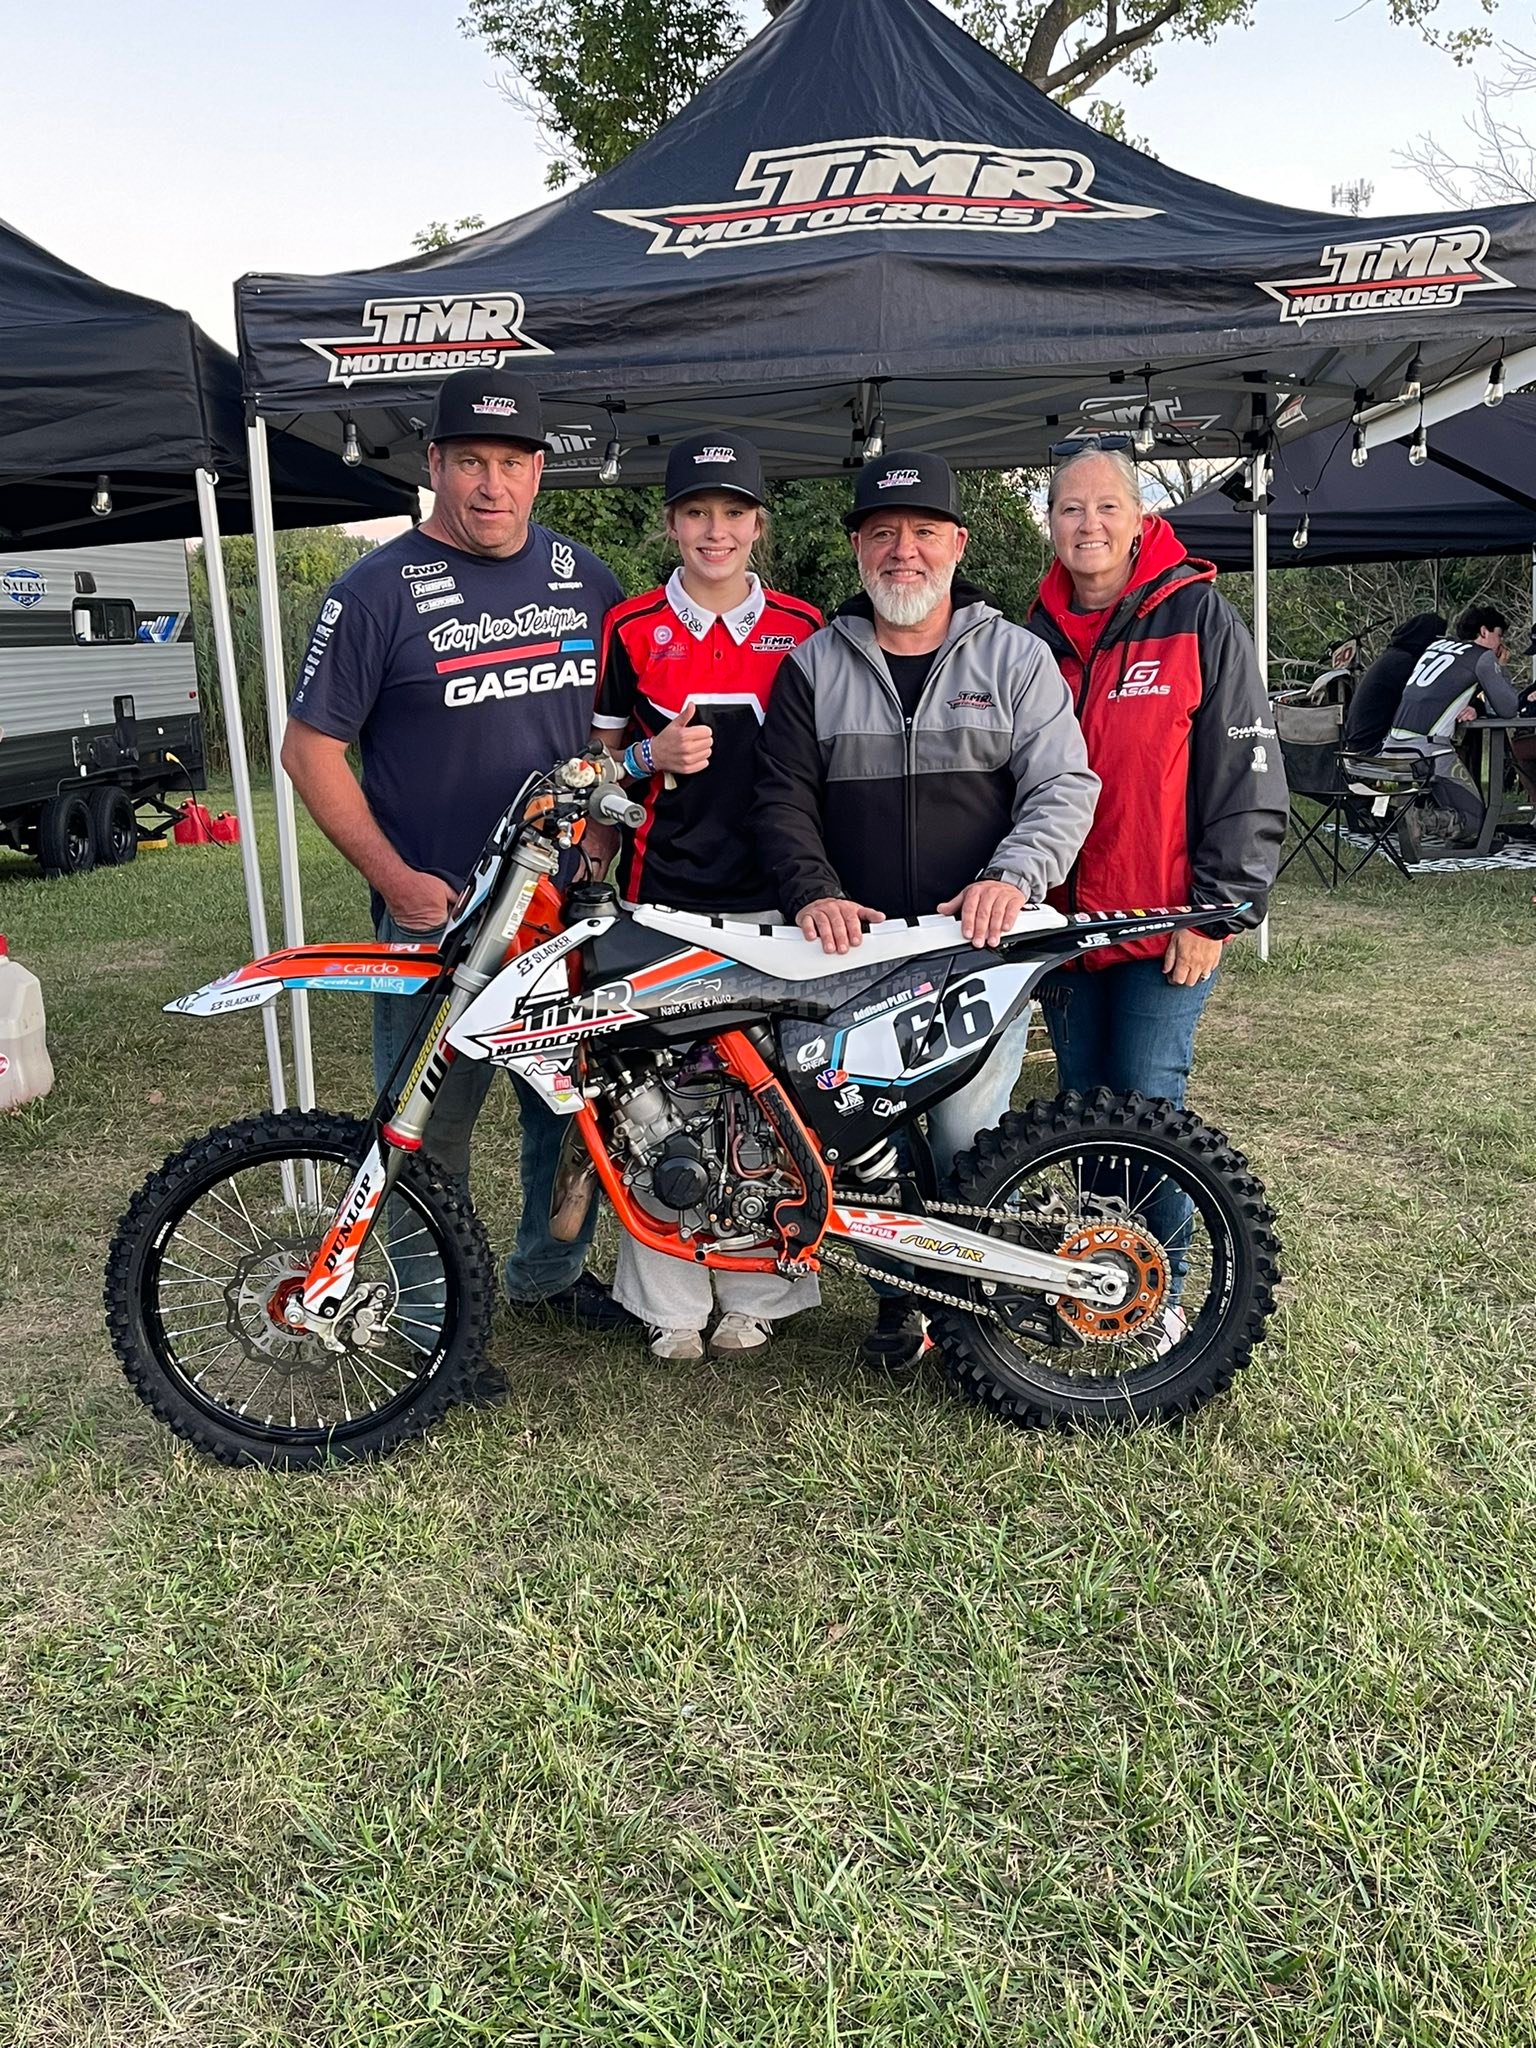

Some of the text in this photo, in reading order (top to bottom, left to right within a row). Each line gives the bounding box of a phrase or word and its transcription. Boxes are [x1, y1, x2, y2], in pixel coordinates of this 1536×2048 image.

[675, 203, 1035, 244] MOTOCROSS
[1290, 284, 1455, 315] MOTOCROSS
[339, 349, 497, 374] MOTOCROSS
[3, 579, 47, 593] SALEM
[430, 619, 478, 652] Troy
[481, 613, 516, 643] Lee
[1406, 651, 1456, 688] 50
[444, 658, 597, 707] GASGAS
[1107, 684, 1171, 700] GASGAS
[532, 935, 572, 963] SLACKER
[343, 962, 399, 974] cardo
[224, 993, 261, 1008] SLACKER
[660, 1003, 686, 1016] Nate's
[687, 1001, 703, 1011] Tire
[712, 994, 732, 1006] Auto
[853, 1001, 889, 1022] Addison
[893, 978, 995, 1070] 66
[496, 1023, 623, 1055] MOTOCROSS
[524, 1057, 574, 1076] ASV
[816, 1068, 837, 1089] VP
[323, 1172, 372, 1275] DUNLOP
[849, 1222, 896, 1239] MOTUL
